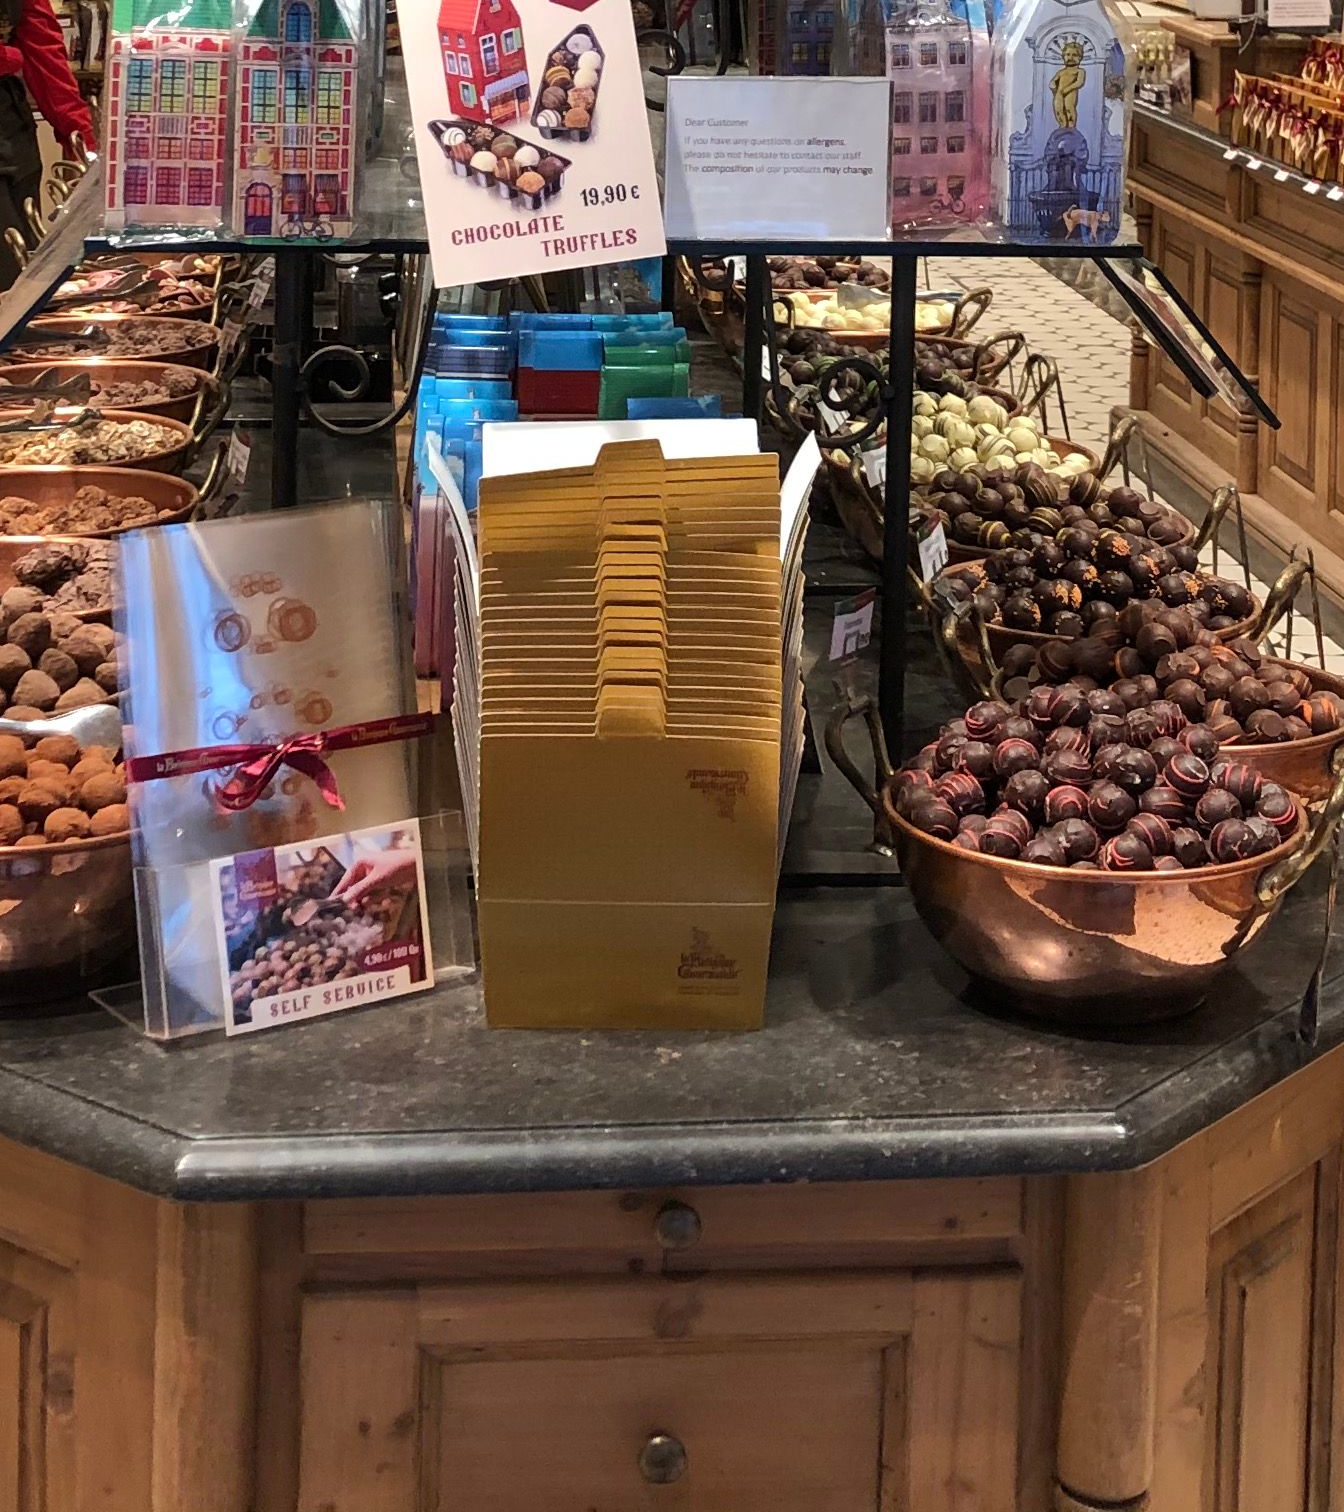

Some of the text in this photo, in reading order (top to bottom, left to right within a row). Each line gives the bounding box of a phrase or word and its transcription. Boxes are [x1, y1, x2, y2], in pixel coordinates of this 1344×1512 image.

[684, 118, 749, 127] Dear Customer
[692, 137, 708, 146] you
[710, 136, 731, 145] have
[733, 138, 749, 147] any
[750, 137, 792, 146] questions
[684, 151, 712, 160] please
[713, 151, 726, 159] do
[727, 151, 742, 159] not
[743, 151, 778, 159] hesitate
[791, 151, 823, 160] contact
[825, 152, 840, 160] our
[684, 164, 700, 173] The
[701, 165, 754, 175] composition
[783, 165, 822, 175] products
[822, 166, 841, 175] may
[579, 183, 640, 207] 19,90 €
[451, 214, 565, 247] CHOCOLATE
[540, 227, 638, 257] TRUFFLES
[269, 974, 396, 1018] SELF SERVICE
